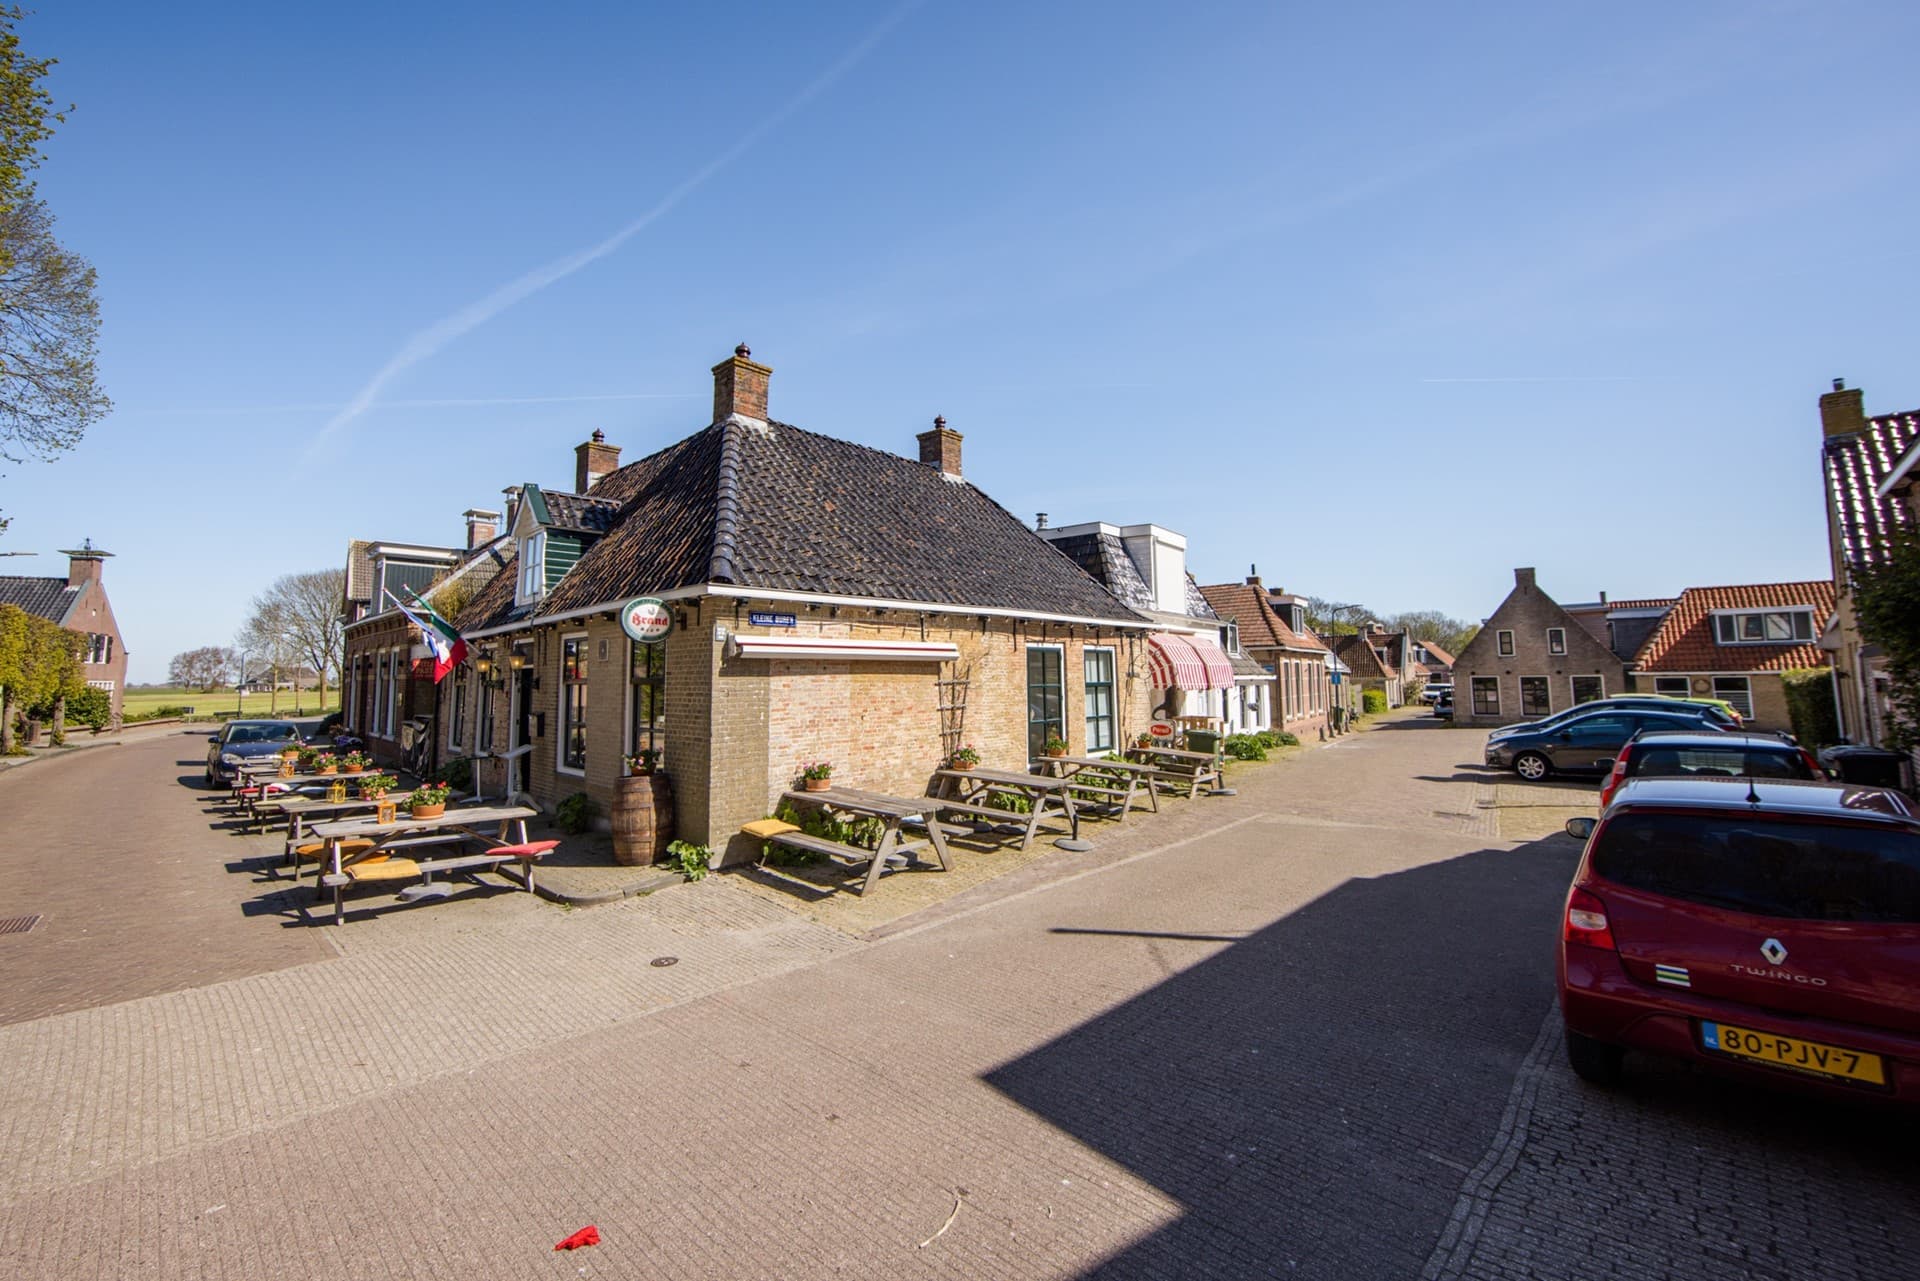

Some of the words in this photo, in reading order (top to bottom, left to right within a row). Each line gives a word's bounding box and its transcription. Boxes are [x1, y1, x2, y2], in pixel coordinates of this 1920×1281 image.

[632, 612, 668, 626] Brand
[752, 613, 773, 623] KLEINE
[1731, 964, 1827, 986] TWINGO
[1705, 1036, 1717, 1045] NL
[1724, 1029, 1860, 1074] 80-PJV-7
